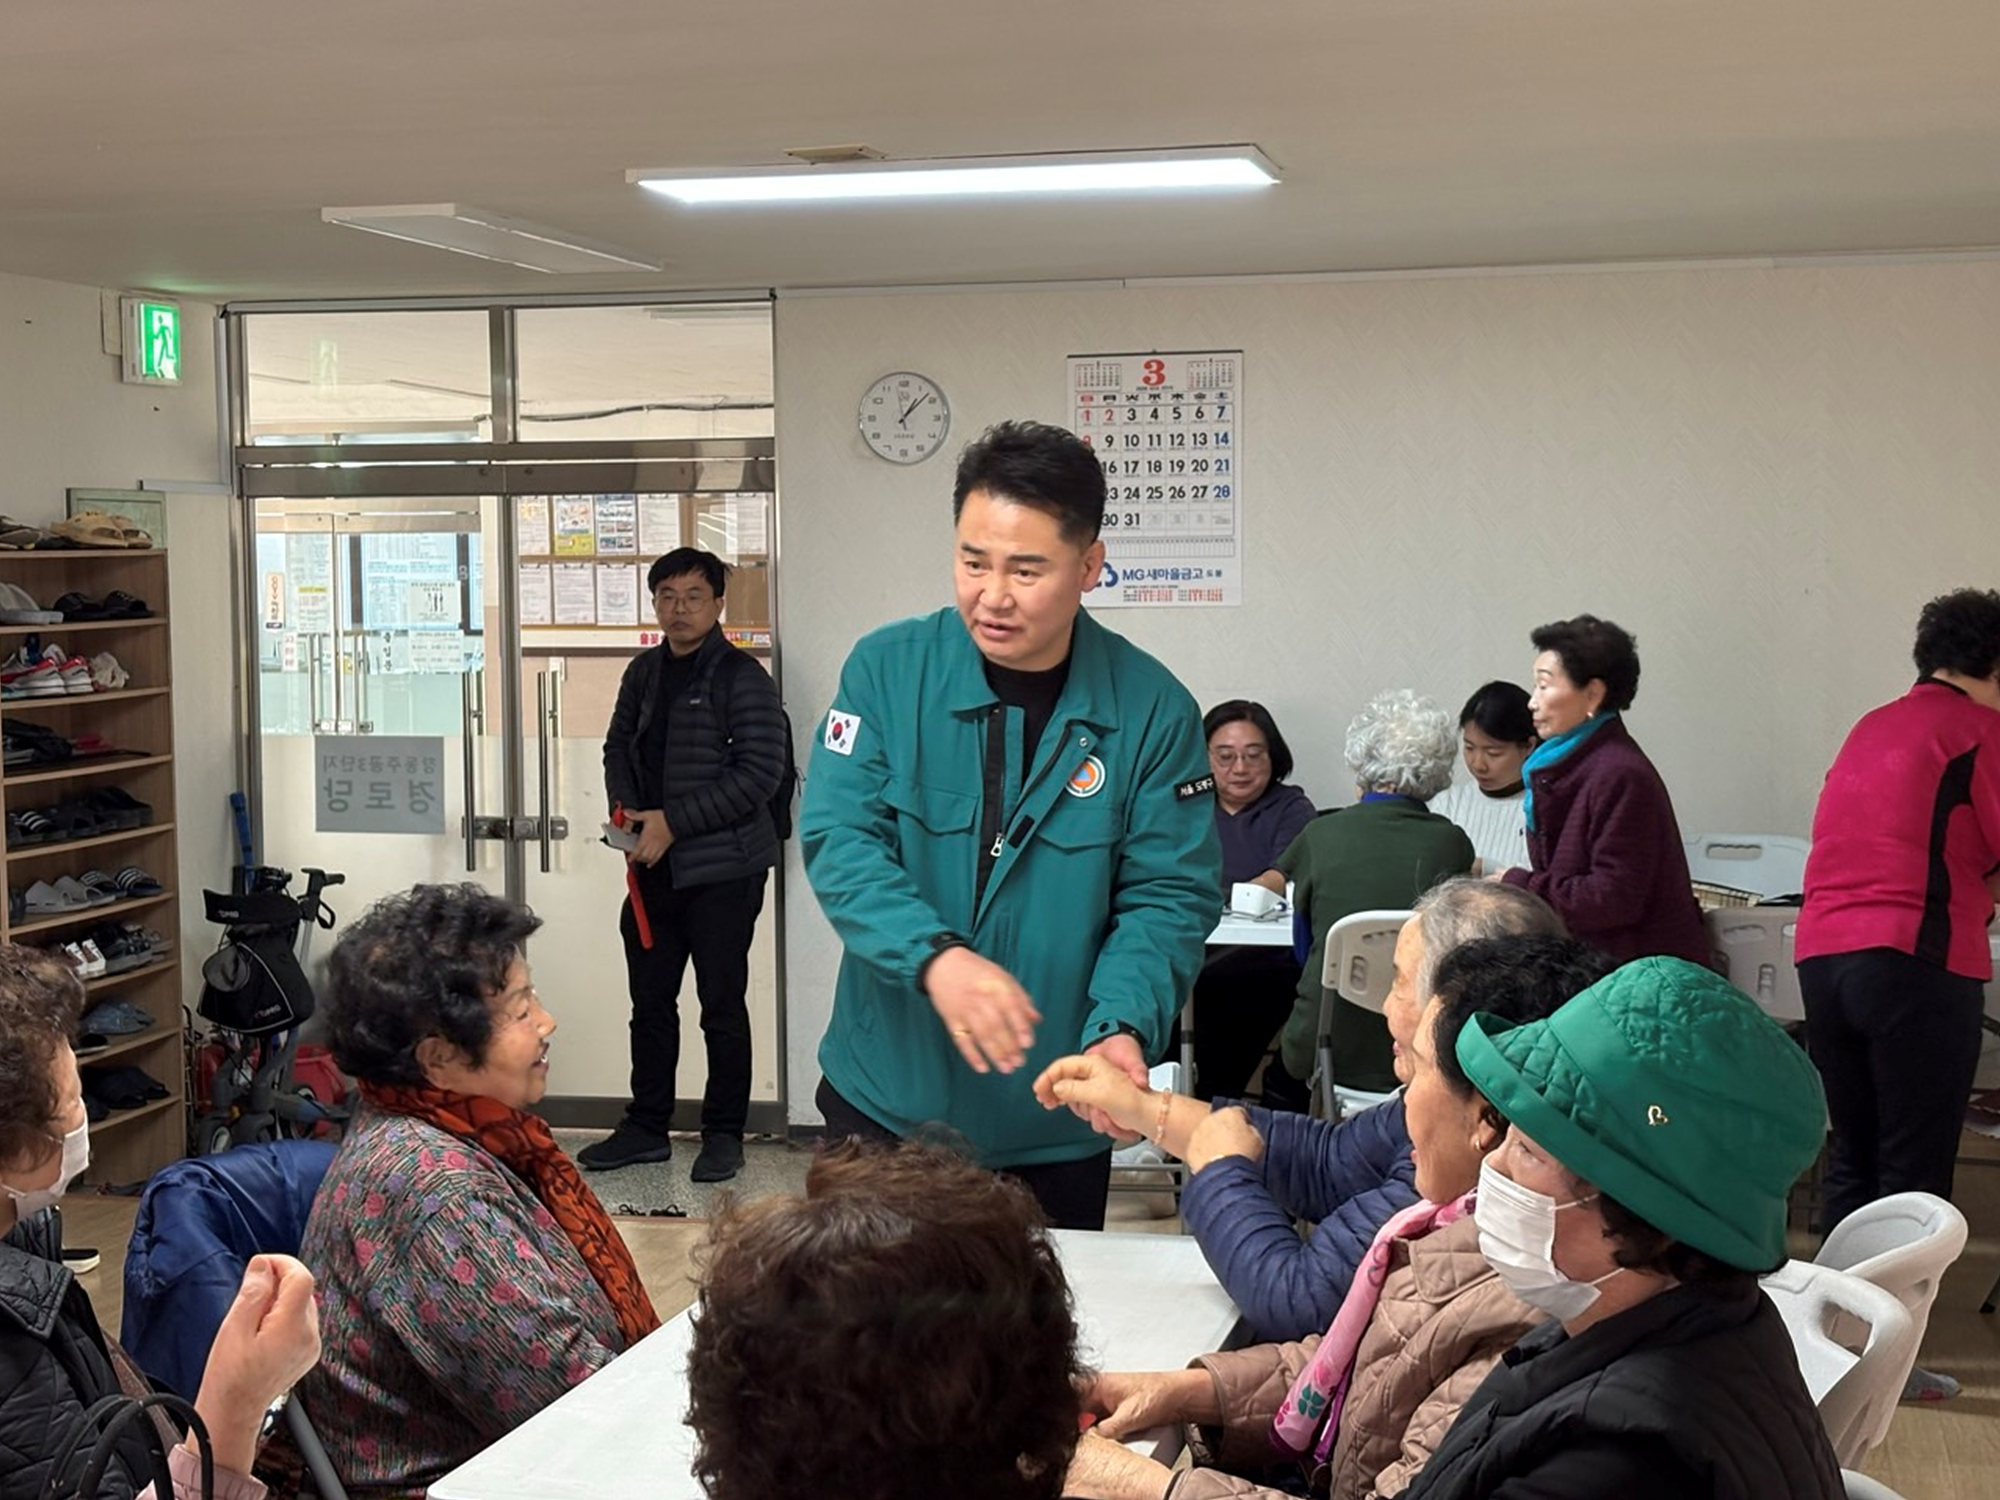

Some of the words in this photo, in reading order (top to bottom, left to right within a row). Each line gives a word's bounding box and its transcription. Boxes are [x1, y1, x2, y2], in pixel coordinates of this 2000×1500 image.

[1142, 359, 1166, 386] 3
[1085, 409, 1091, 422] 1
[1105, 409, 1114, 421] 2
[1127, 408, 1137, 421] 3
[1150, 407, 1159, 420] 4
[1173, 407, 1182, 420] 5
[1195, 406, 1204, 419] 6
[1217, 406, 1226, 419] 7
[1105, 435, 1114, 447] 9
[1125, 434, 1140, 447] 10
[1148, 434, 1161, 446] 11
[1170, 433, 1185, 446] 12
[1192, 432, 1208, 445] 13
[1214, 432, 1230, 445] 14
[1124, 461, 1139, 473] 17
[1147, 460, 1162, 473] 18
[1170, 460, 1185, 472] 19
[1191, 459, 1209, 472] 20
[1214, 459, 1230, 471] 21
[1124, 487, 1140, 499] 24
[1146, 486, 1163, 499] 25
[1169, 486, 1186, 499] 26
[1191, 485, 1208, 498] 27
[1213, 485, 1230, 498] 28
[1125, 513, 1140, 526] 31
[1180, 783, 1194, 797] 서울
[1195, 778, 1214, 791] 도봉구
